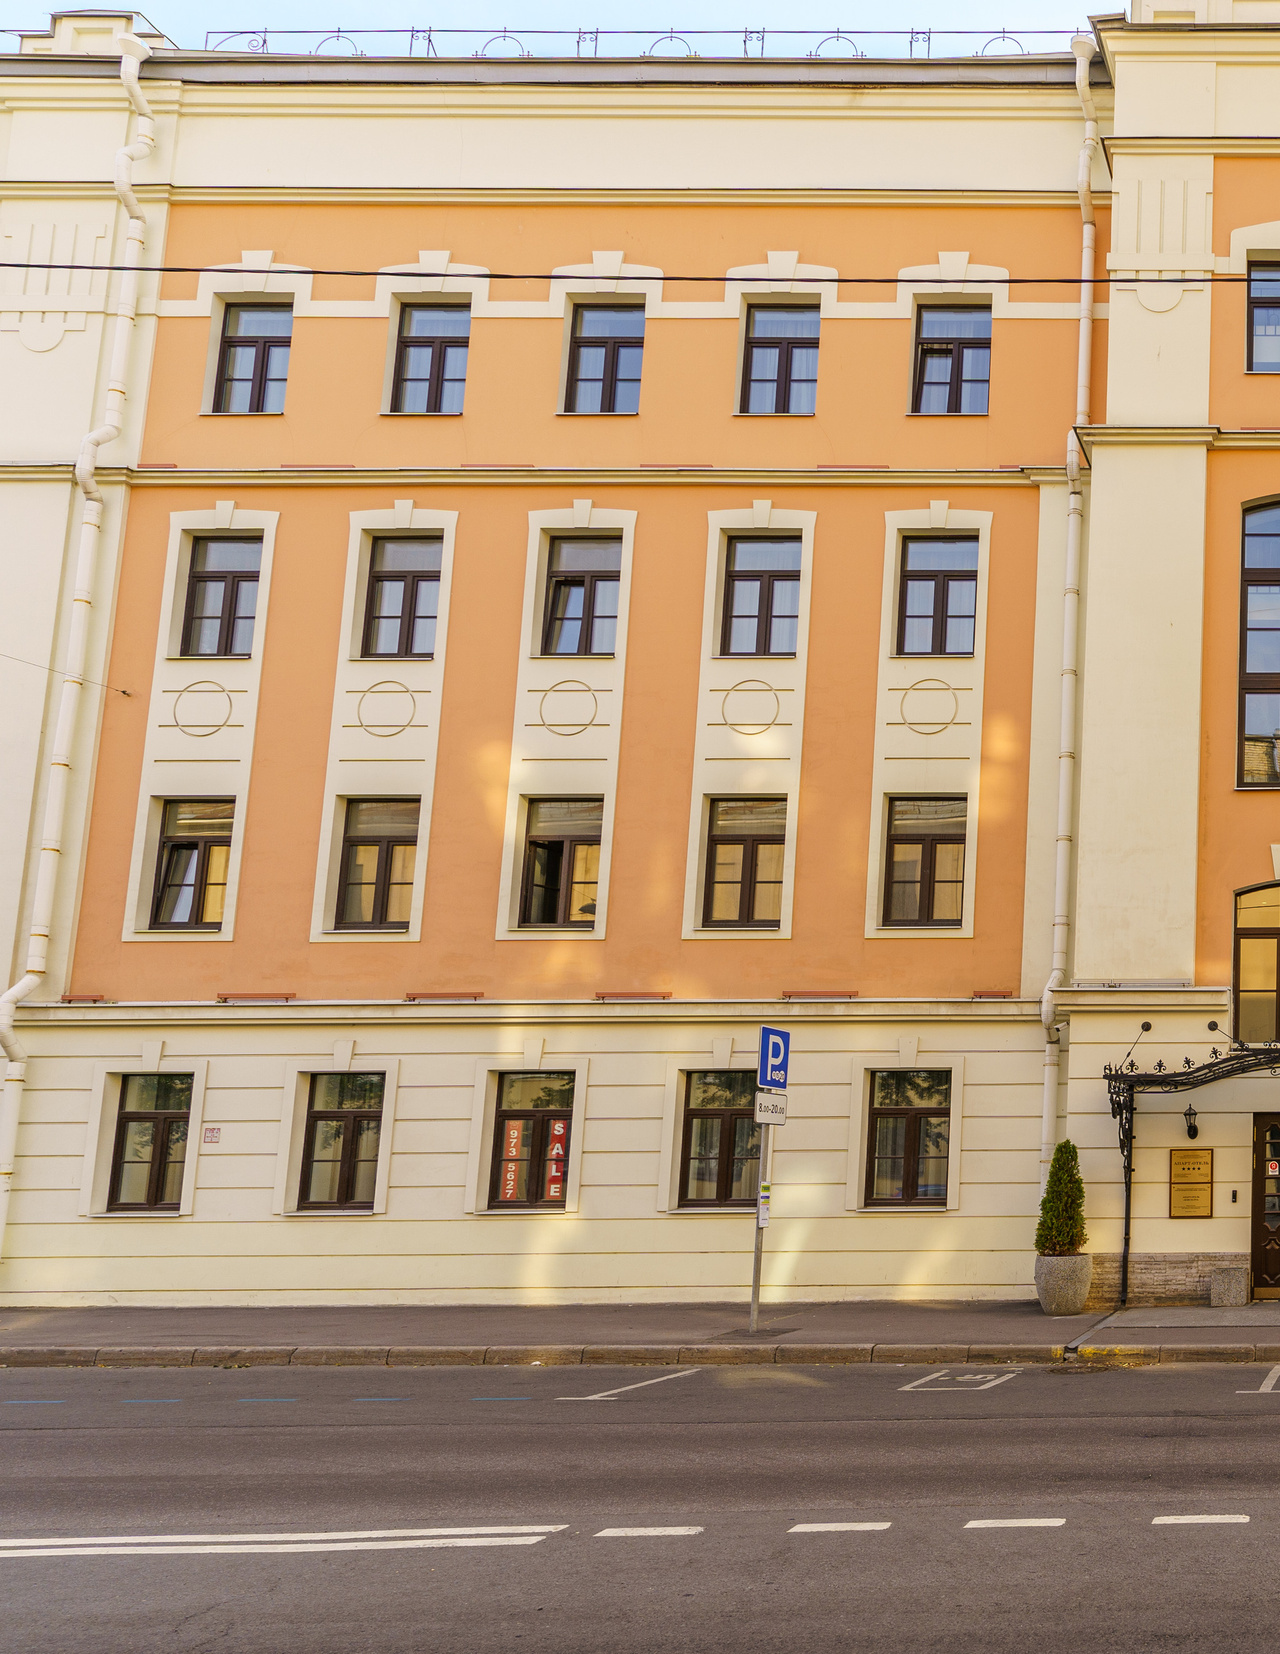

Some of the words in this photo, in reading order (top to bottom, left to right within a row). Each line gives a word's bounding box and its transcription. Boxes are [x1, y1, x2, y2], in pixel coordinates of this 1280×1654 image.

[767, 1034, 785, 1080] P
[758, 1103, 785, 1115] 8.00-20.00
[550, 1123, 564, 1196] SALE
